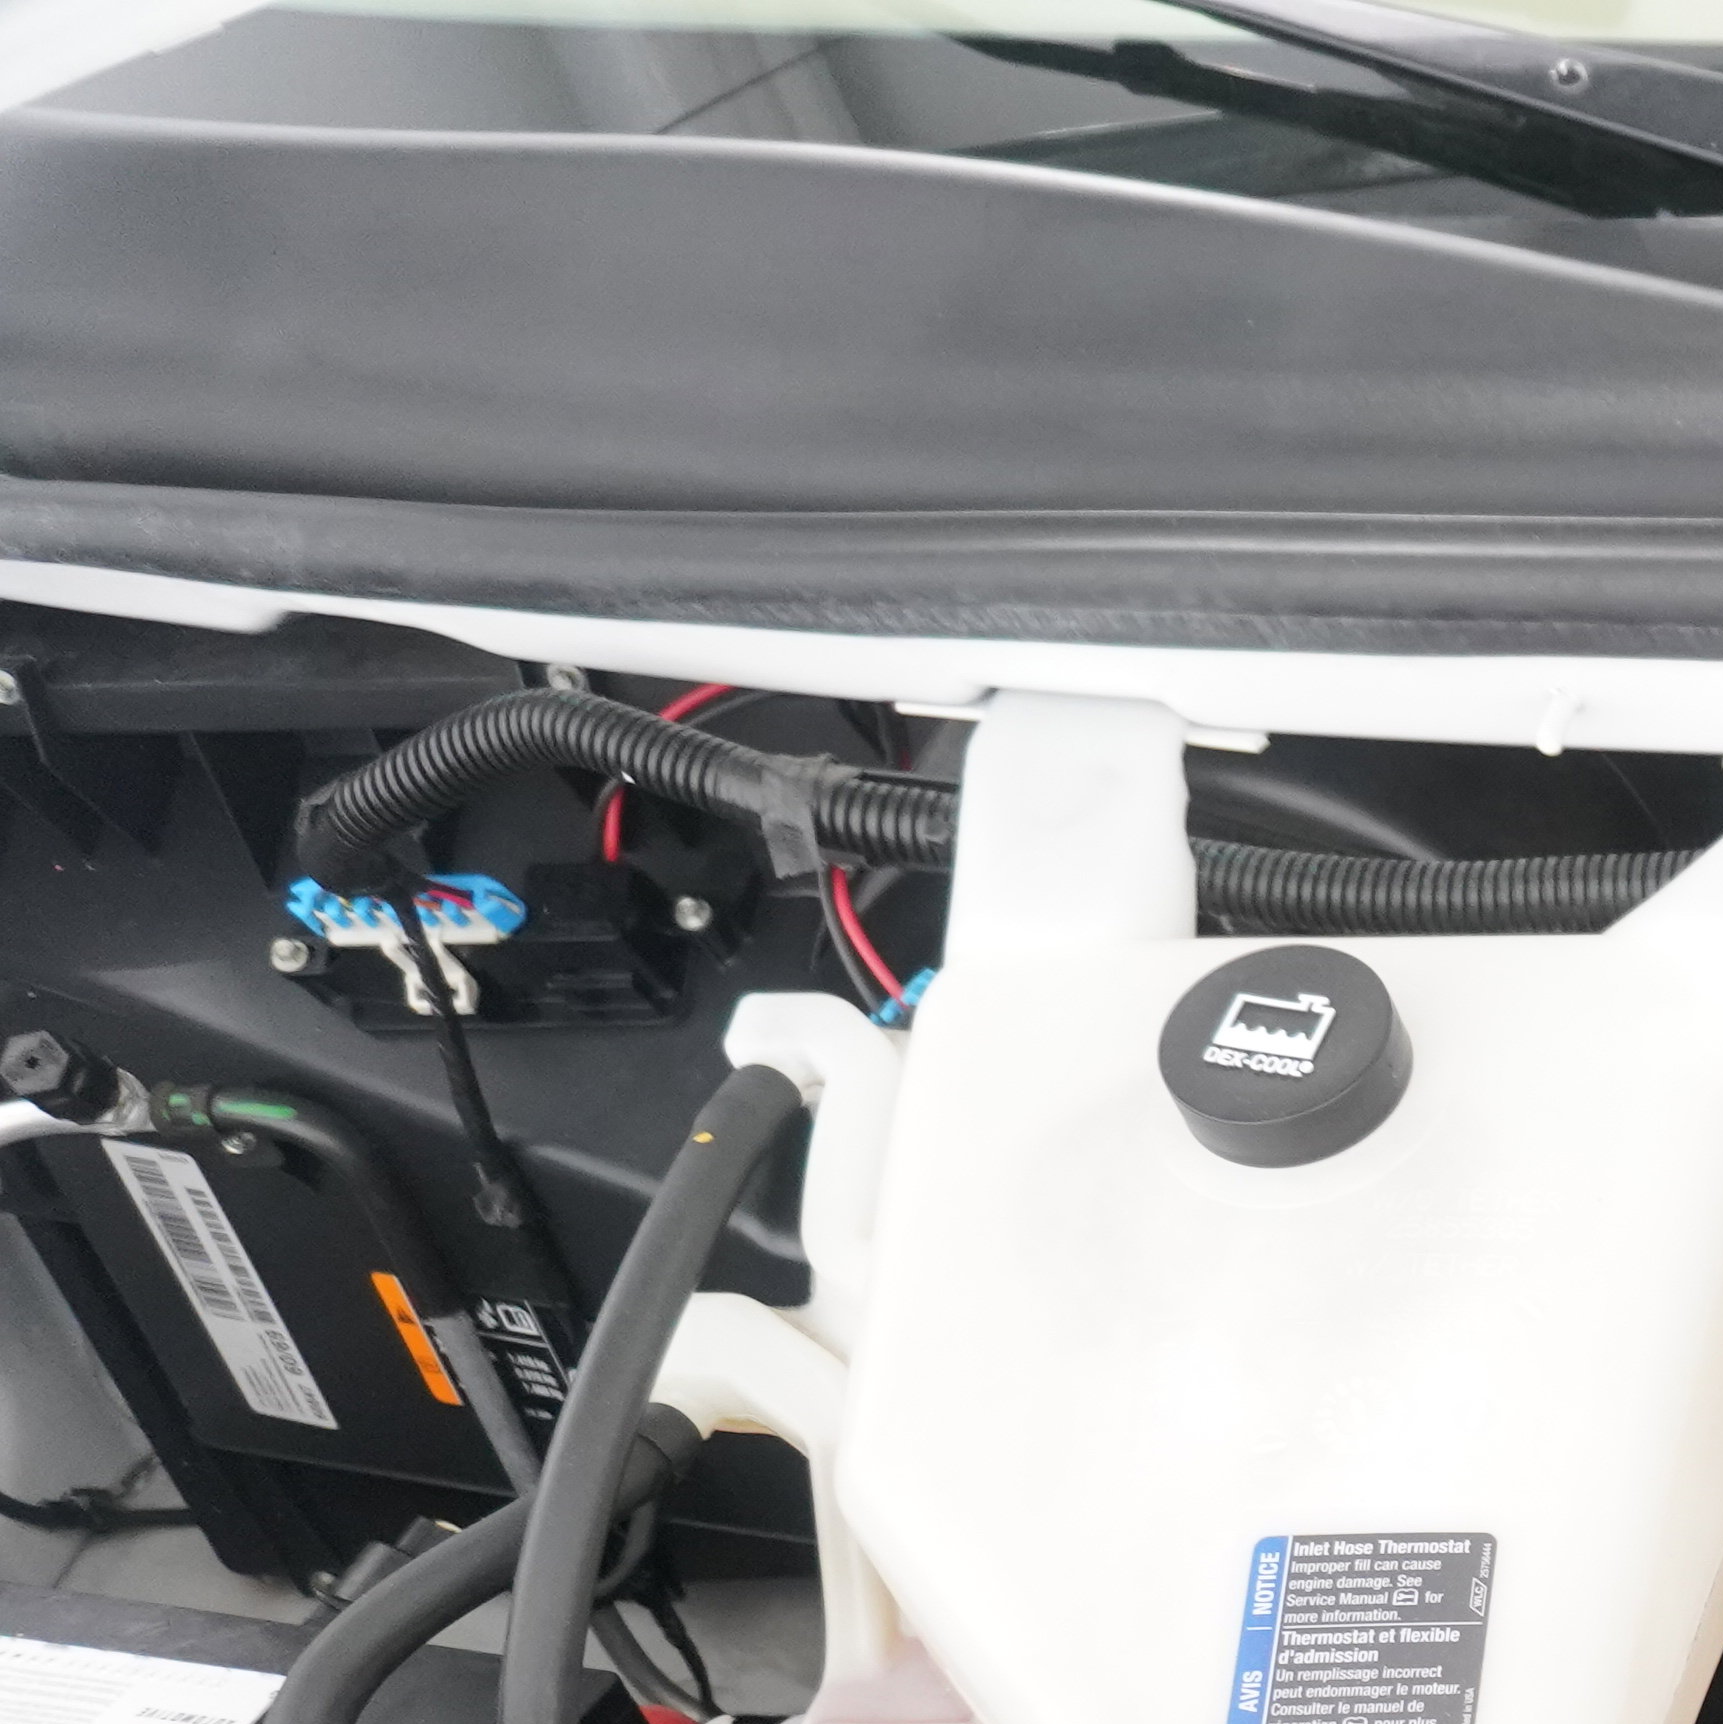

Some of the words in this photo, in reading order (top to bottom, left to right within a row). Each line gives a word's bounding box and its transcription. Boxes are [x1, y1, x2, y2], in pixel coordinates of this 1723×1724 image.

[1293, 1541, 1330, 1556] Inlet
[1333, 1540, 1374, 1556] Hose
[1378, 1539, 1472, 1554] Thermostat
[1291, 1560, 1351, 1574] Improper
[1354, 1558, 1371, 1571] fill
[1373, 1560, 1399, 1572] can
[1401, 1559, 1442, 1571] cause
[1252, 1551, 1280, 1616] NOTICE
[1288, 1577, 1333, 1592] engine
[1336, 1575, 1393, 1591] damage.
[1396, 1574, 1423, 1588] See
[1285, 1592, 1336, 1607] Service
[1338, 1591, 1389, 1606] Manual
[1424, 1591, 1444, 1604] for
[1473, 1586, 1485, 1608] WLC
[1284, 1611, 1319, 1624] more
[1321, 1609, 1402, 1623] information.
[1281, 1629, 1376, 1647] Thermostat
[1378, 1629, 1395, 1644] et
[1399, 1627, 1461, 1643] flexible
[1278, 1648, 1380, 1665] d'admission
[1275, 1669, 1294, 1683] Un
[1297, 1666, 1380, 1683] remplissage
[1382, 1665, 1443, 1680] incorrect
[1238, 1670, 1263, 1713] AVIS
[1272, 1686, 1303, 1701] peut
[1305, 1685, 1393, 1700] endommager
[1396, 1683, 1408, 1697] le
[1411, 1683, 1462, 1697] moteur.
[1465, 1687, 1476, 1703] USA
[1270, 1702, 1335, 1718] Consulter
[1338, 1701, 1351, 1716] le
[1353, 1701, 1405, 1715] manuel
[1407, 1700, 1425, 1714] de
